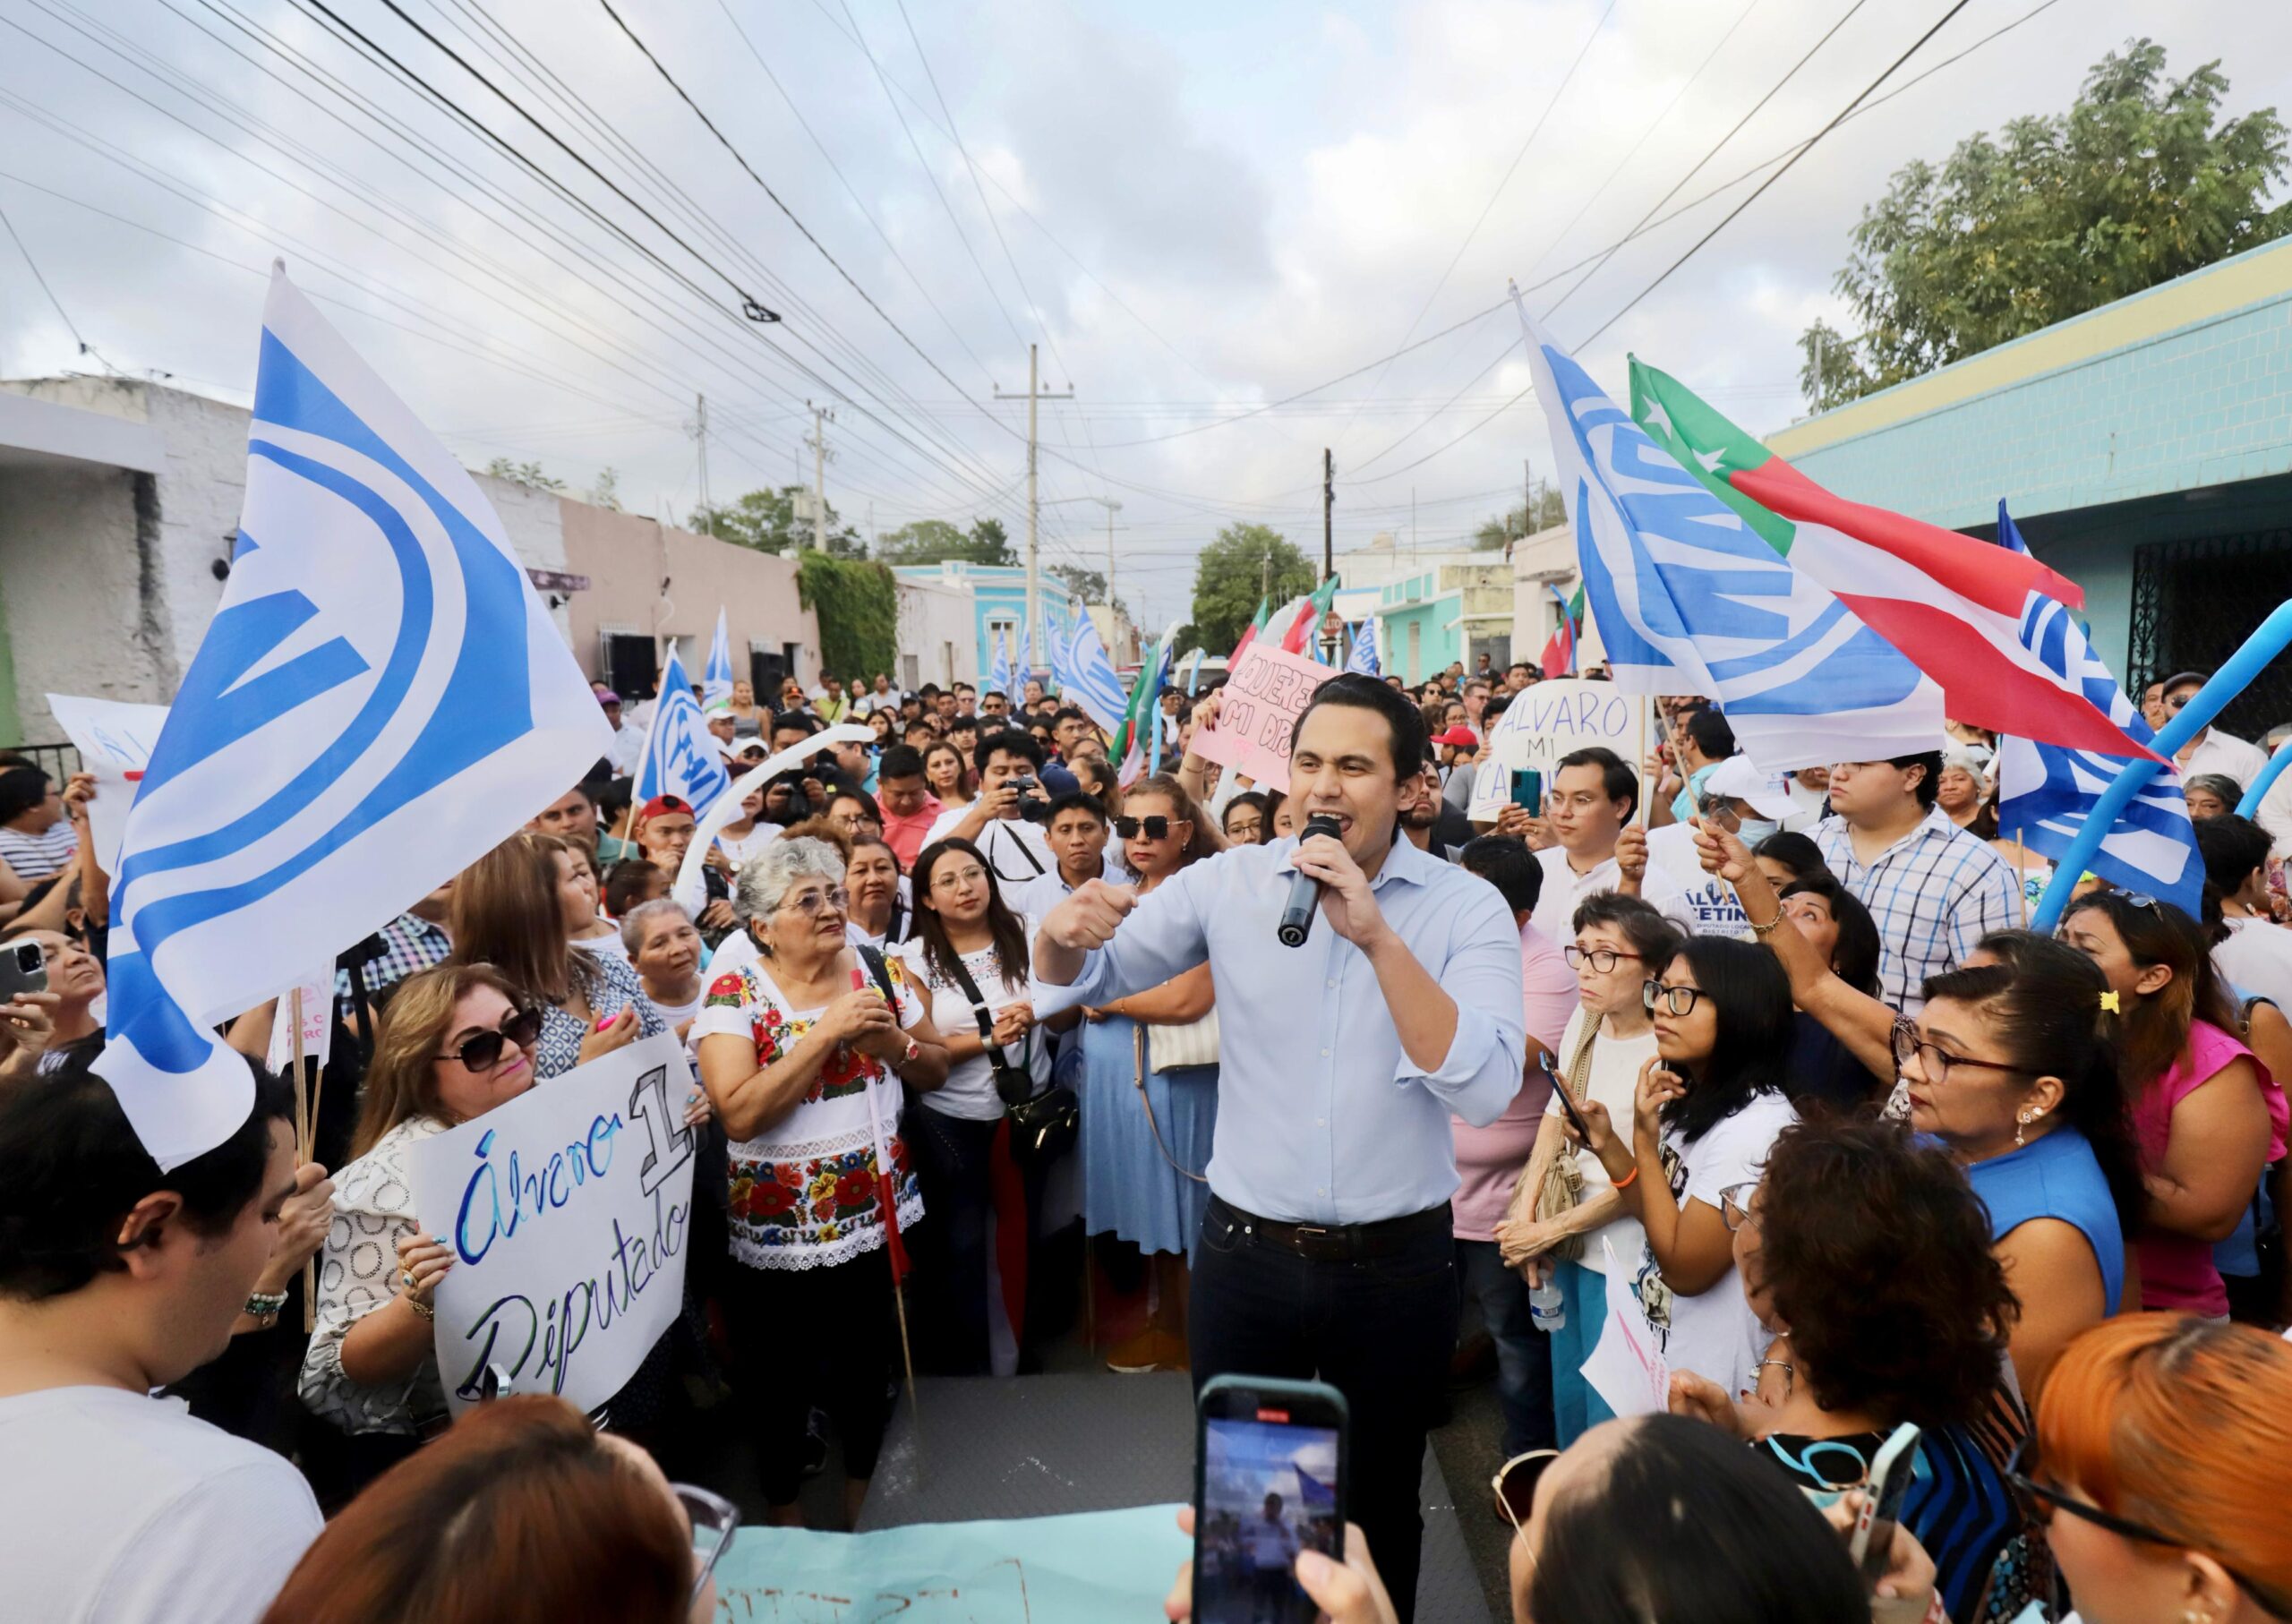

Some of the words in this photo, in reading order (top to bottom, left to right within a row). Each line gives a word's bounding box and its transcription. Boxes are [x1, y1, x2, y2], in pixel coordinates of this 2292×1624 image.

[1324, 620, 1342, 629] LTO
[1222, 699, 1254, 735] MI
[1527, 736, 1554, 760] MI
[1693, 907, 1748, 921] ETIN
[455, 1113, 623, 1266] Álvaro
[629, 1064, 694, 1198] 1
[455, 1188, 689, 1402] Diputado
